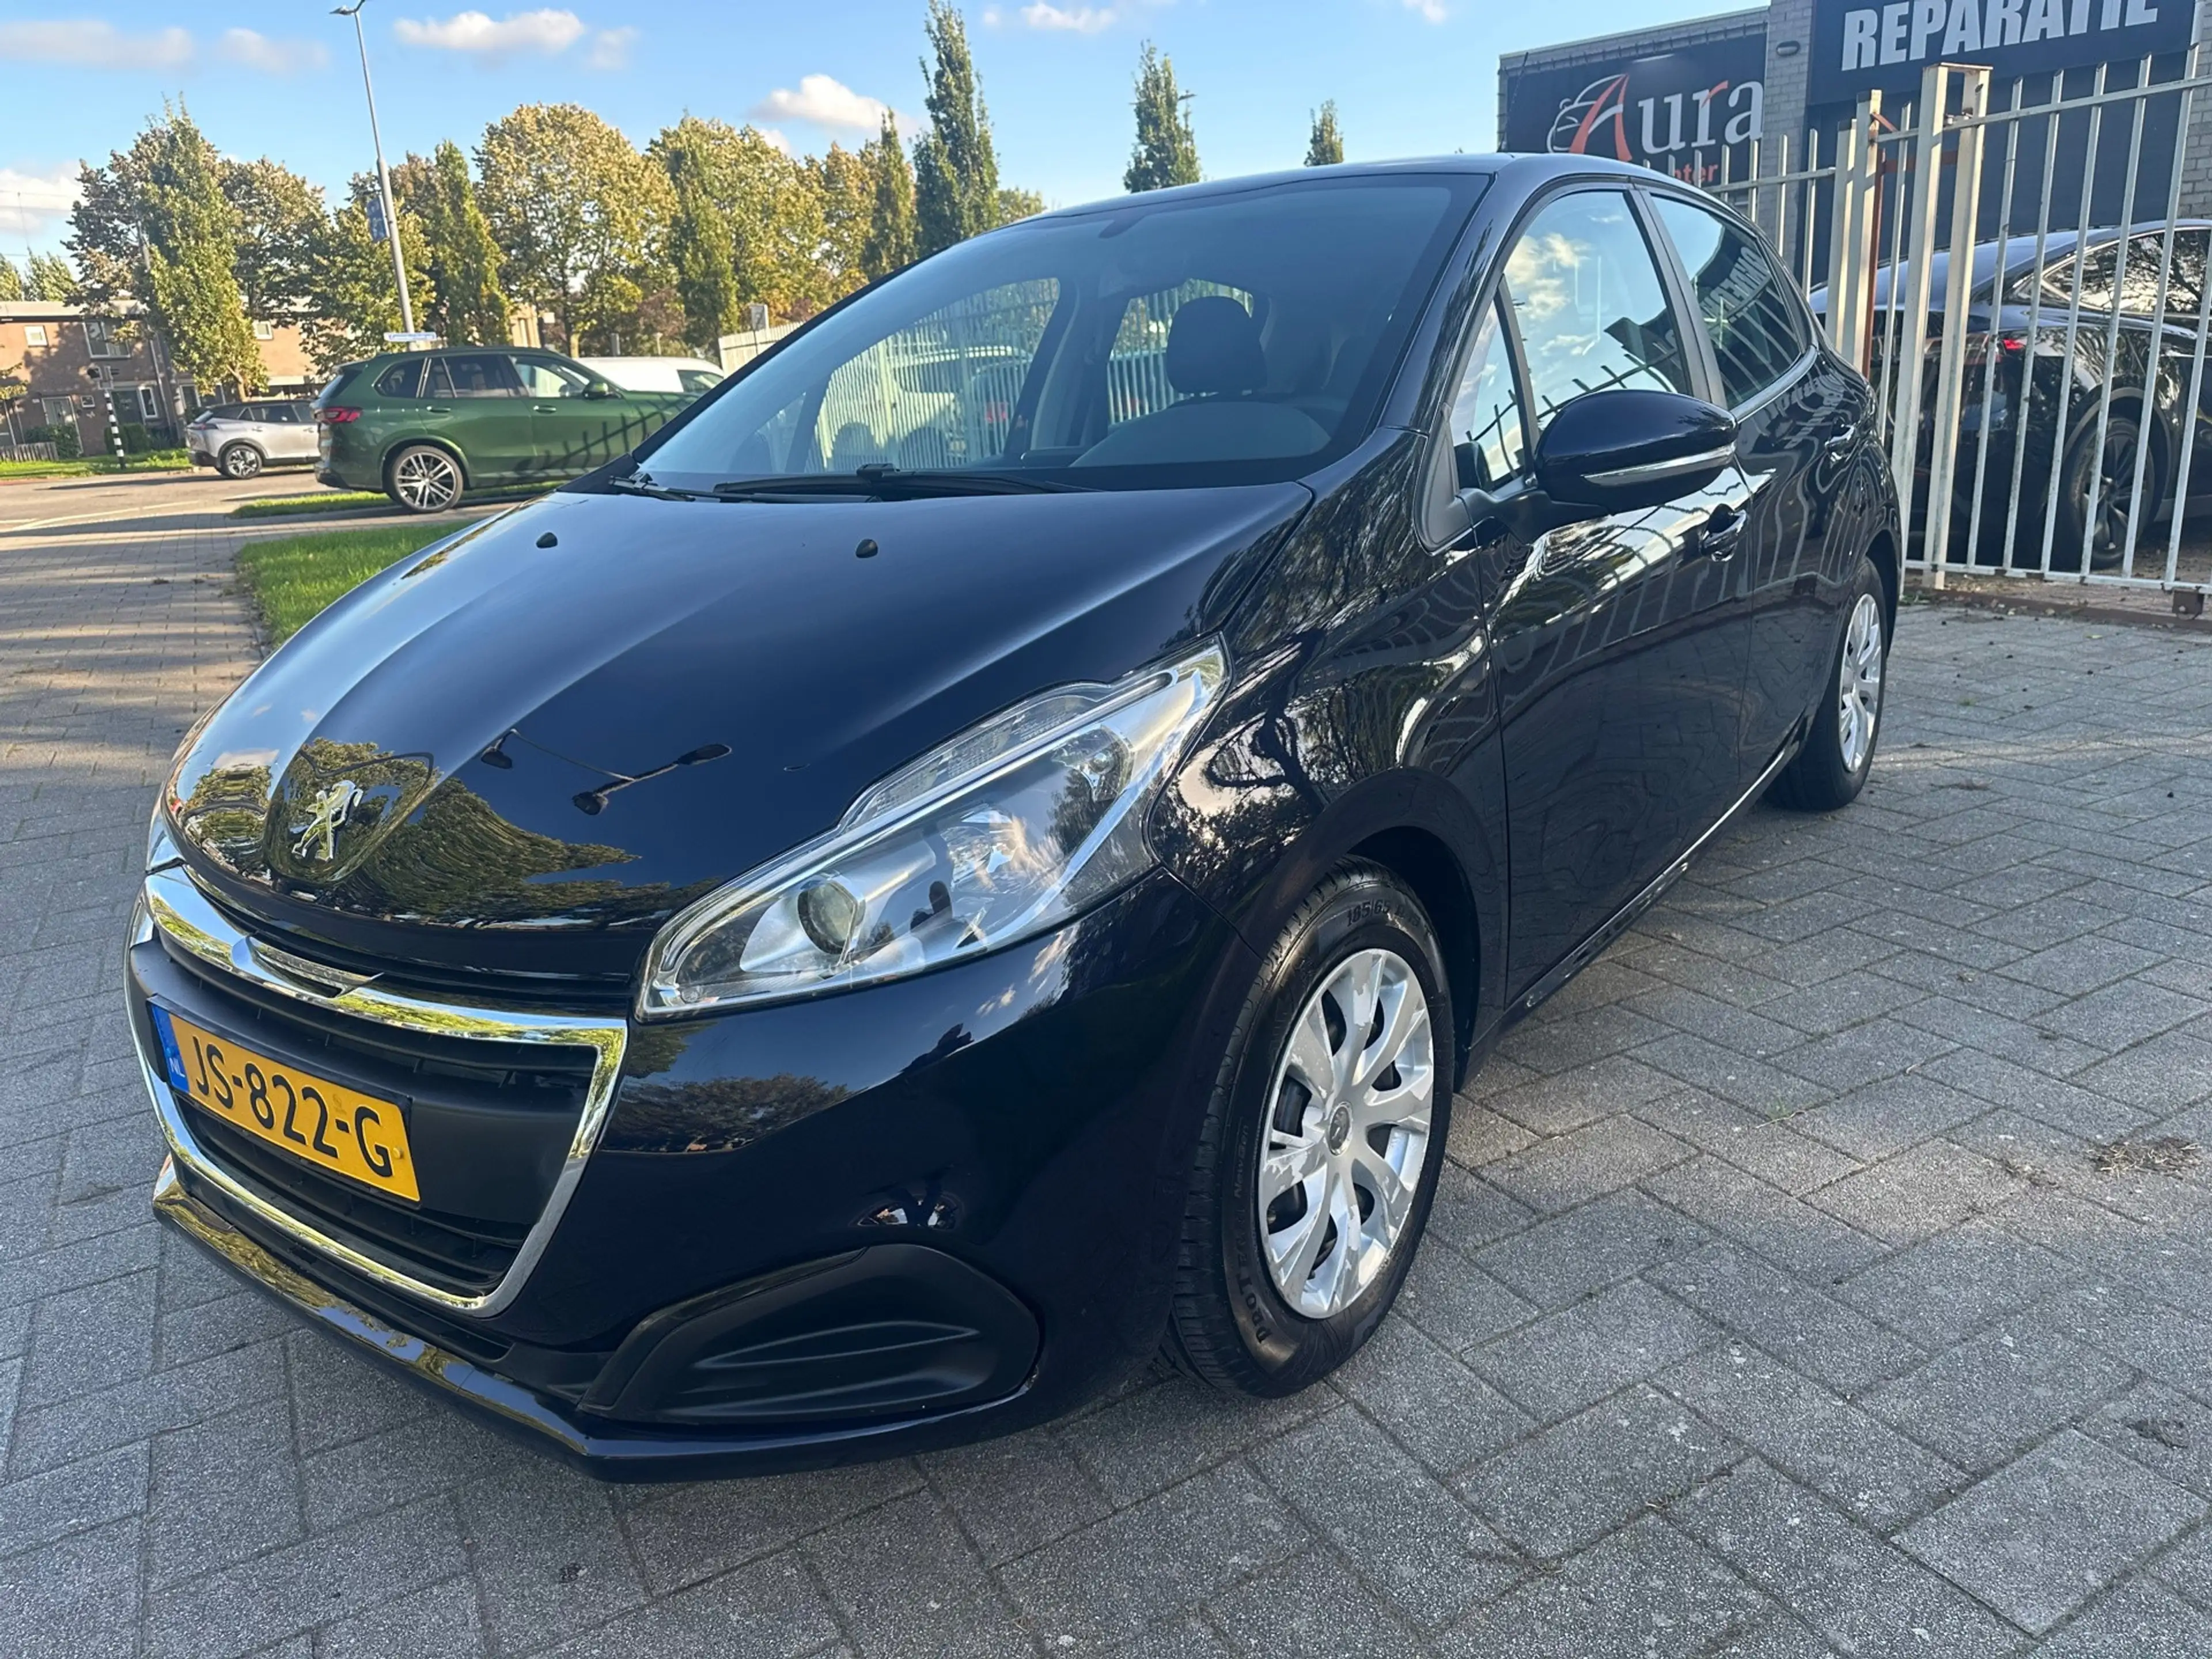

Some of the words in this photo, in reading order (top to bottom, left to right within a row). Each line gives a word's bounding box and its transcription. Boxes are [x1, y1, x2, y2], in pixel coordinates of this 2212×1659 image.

[1569, 74, 1763, 161] Aura
[169, 1058, 185, 1078] NL
[192, 1036, 393, 1177] JS-822-G
